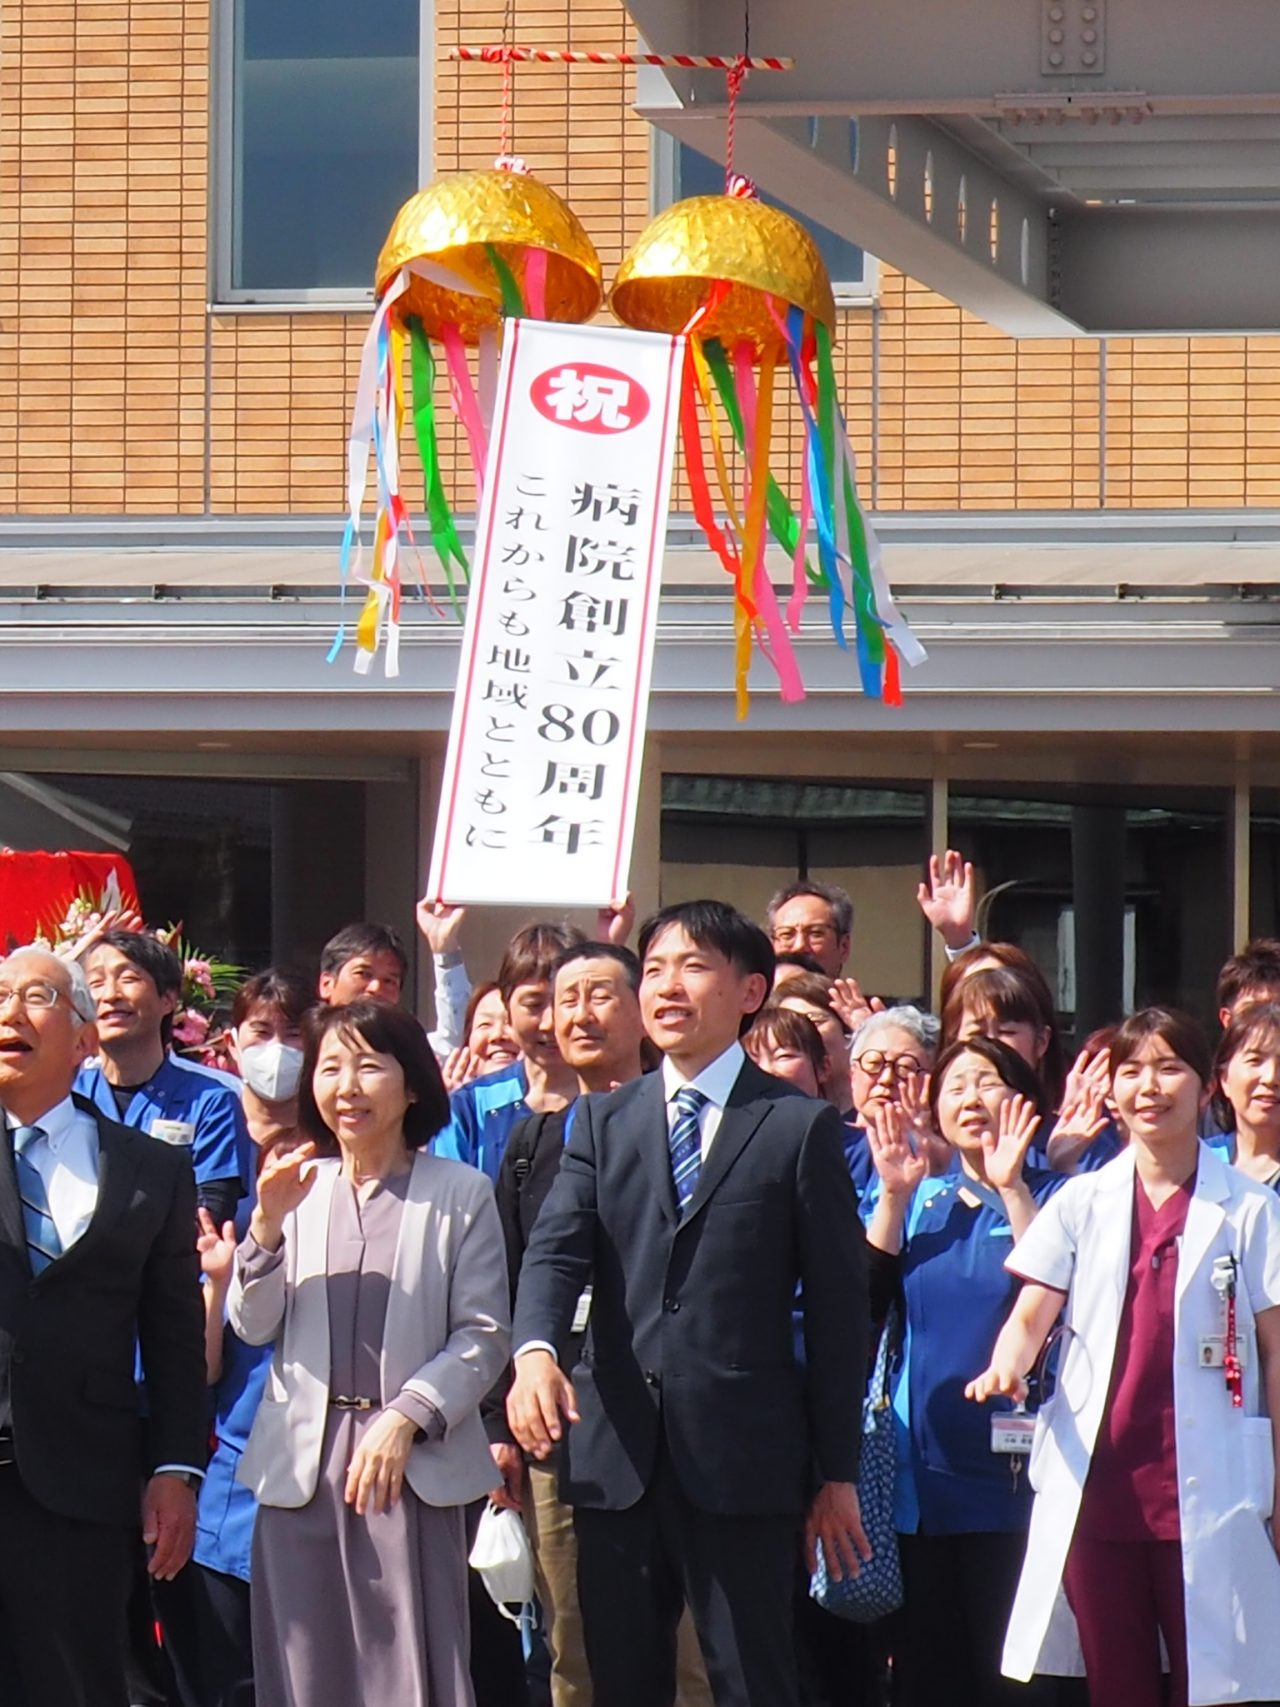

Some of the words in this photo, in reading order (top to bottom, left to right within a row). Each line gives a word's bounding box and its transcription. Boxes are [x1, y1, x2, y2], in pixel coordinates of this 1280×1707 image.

[544, 368, 631, 430] 祝
[465, 472, 551, 850] これからも地域とともに
[527, 480, 643, 855] 病院創立80周年
